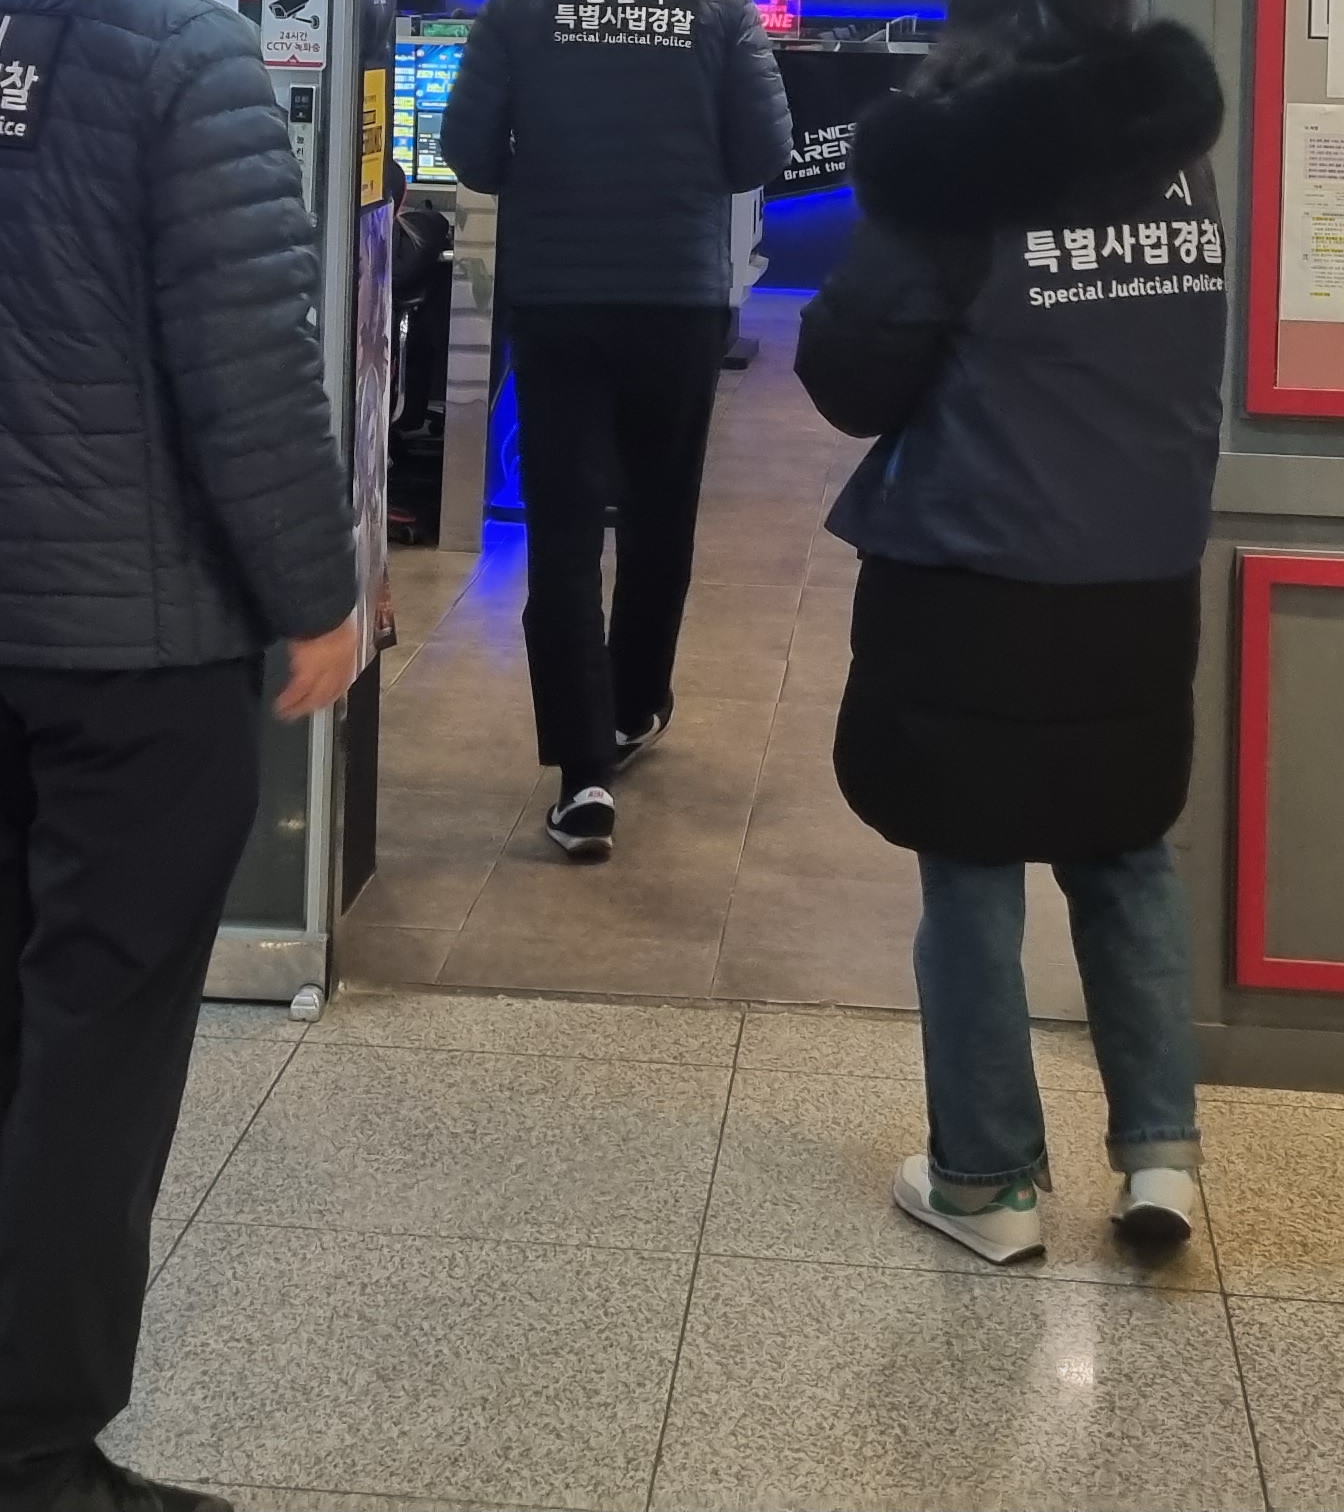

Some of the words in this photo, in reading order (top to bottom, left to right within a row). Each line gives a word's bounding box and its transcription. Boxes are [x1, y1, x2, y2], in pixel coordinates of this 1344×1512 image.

[554, 3, 696, 35] 특별사법경찰
[266, 41, 292, 51] CCTV
[553, 31, 600, 45] Special
[603, 32, 651, 46] Judicial
[654, 35, 692, 48] Police
[783, 164, 821, 181] Break
[824, 161, 846, 173] the
[1023, 218, 1223, 274] 특별사법경찰
[1028, 280, 1105, 308] Special
[1108, 276, 1180, 299] Judicial
[1182, 274, 1225, 293] Police
